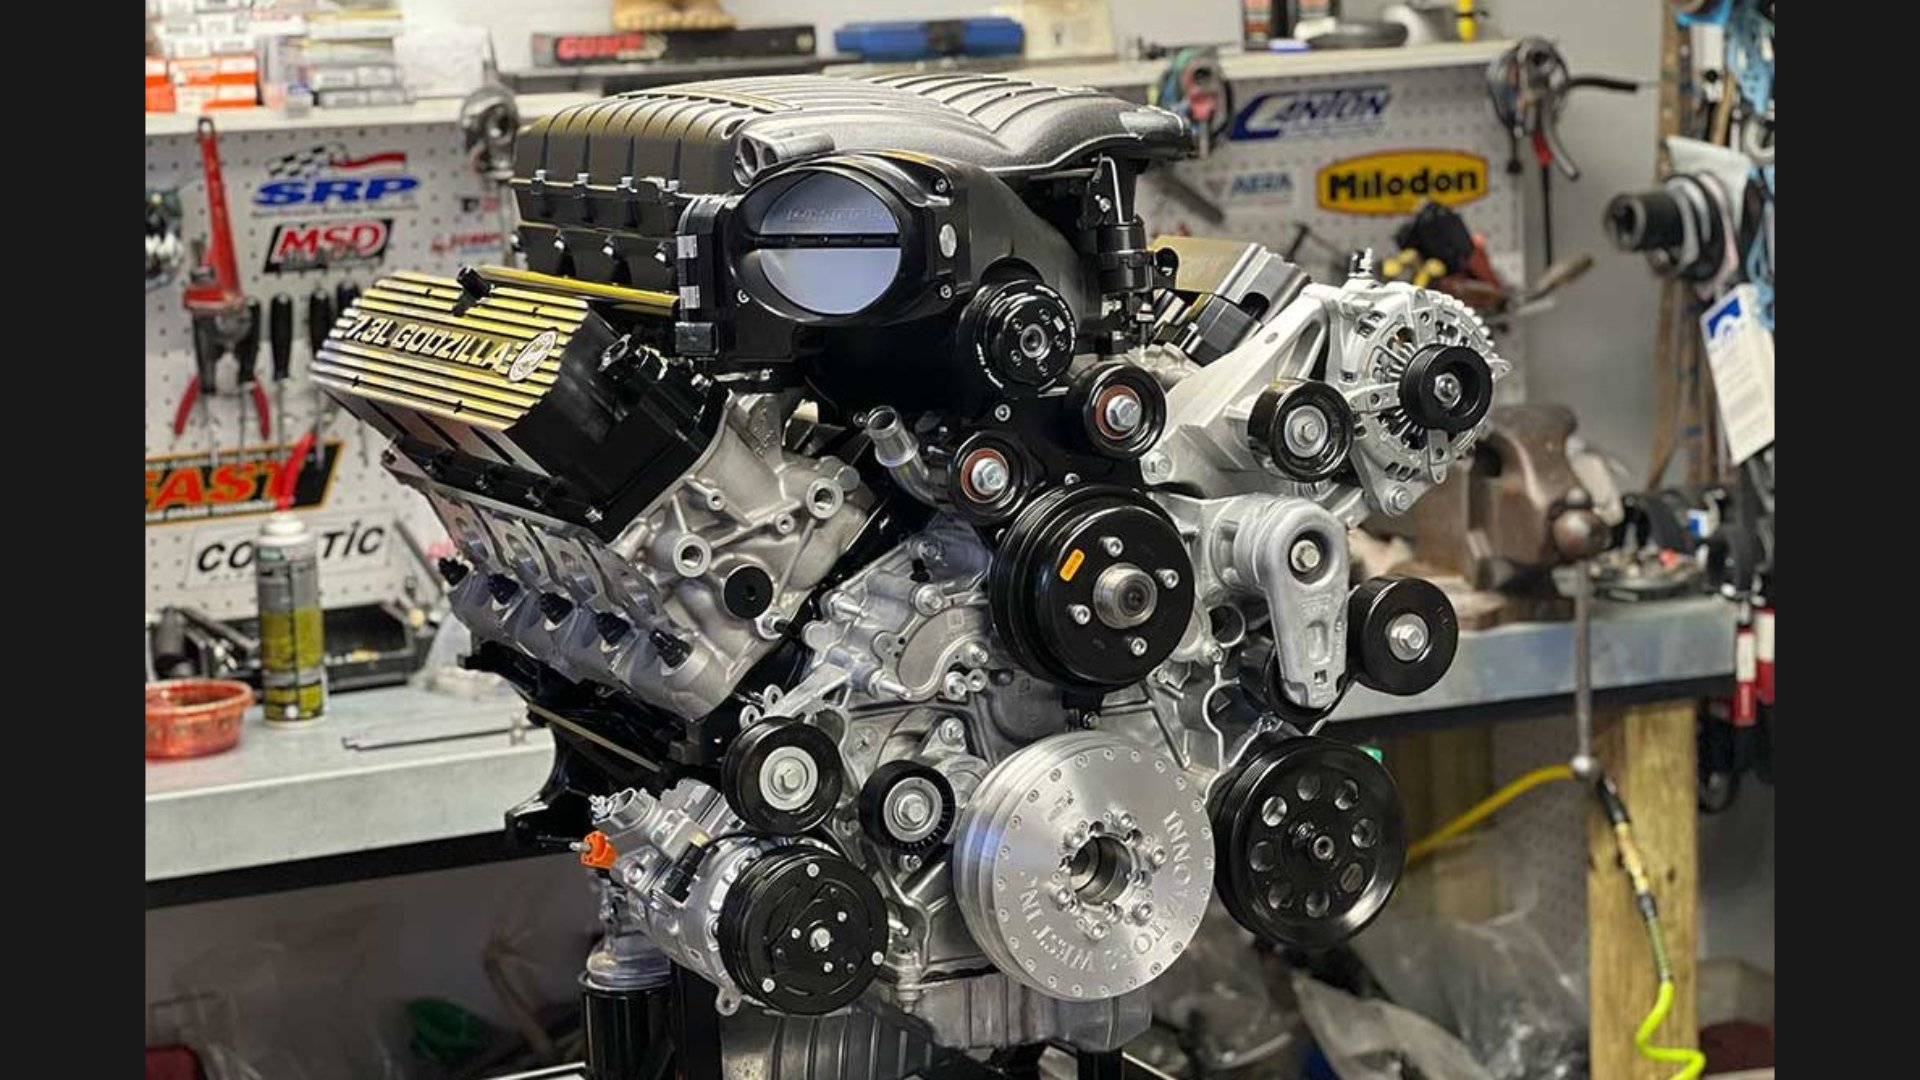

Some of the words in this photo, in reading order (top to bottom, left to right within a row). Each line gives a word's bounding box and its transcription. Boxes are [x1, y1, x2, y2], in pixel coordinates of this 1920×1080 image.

[253, 177, 419, 206] SRP
[1328, 167, 1478, 203] Milodon
[275, 223, 384, 260] MSD
[346, 315, 395, 347] 7.3L
[391, 322, 508, 375] GODZILLA
[197, 517, 385, 573] COTIC
